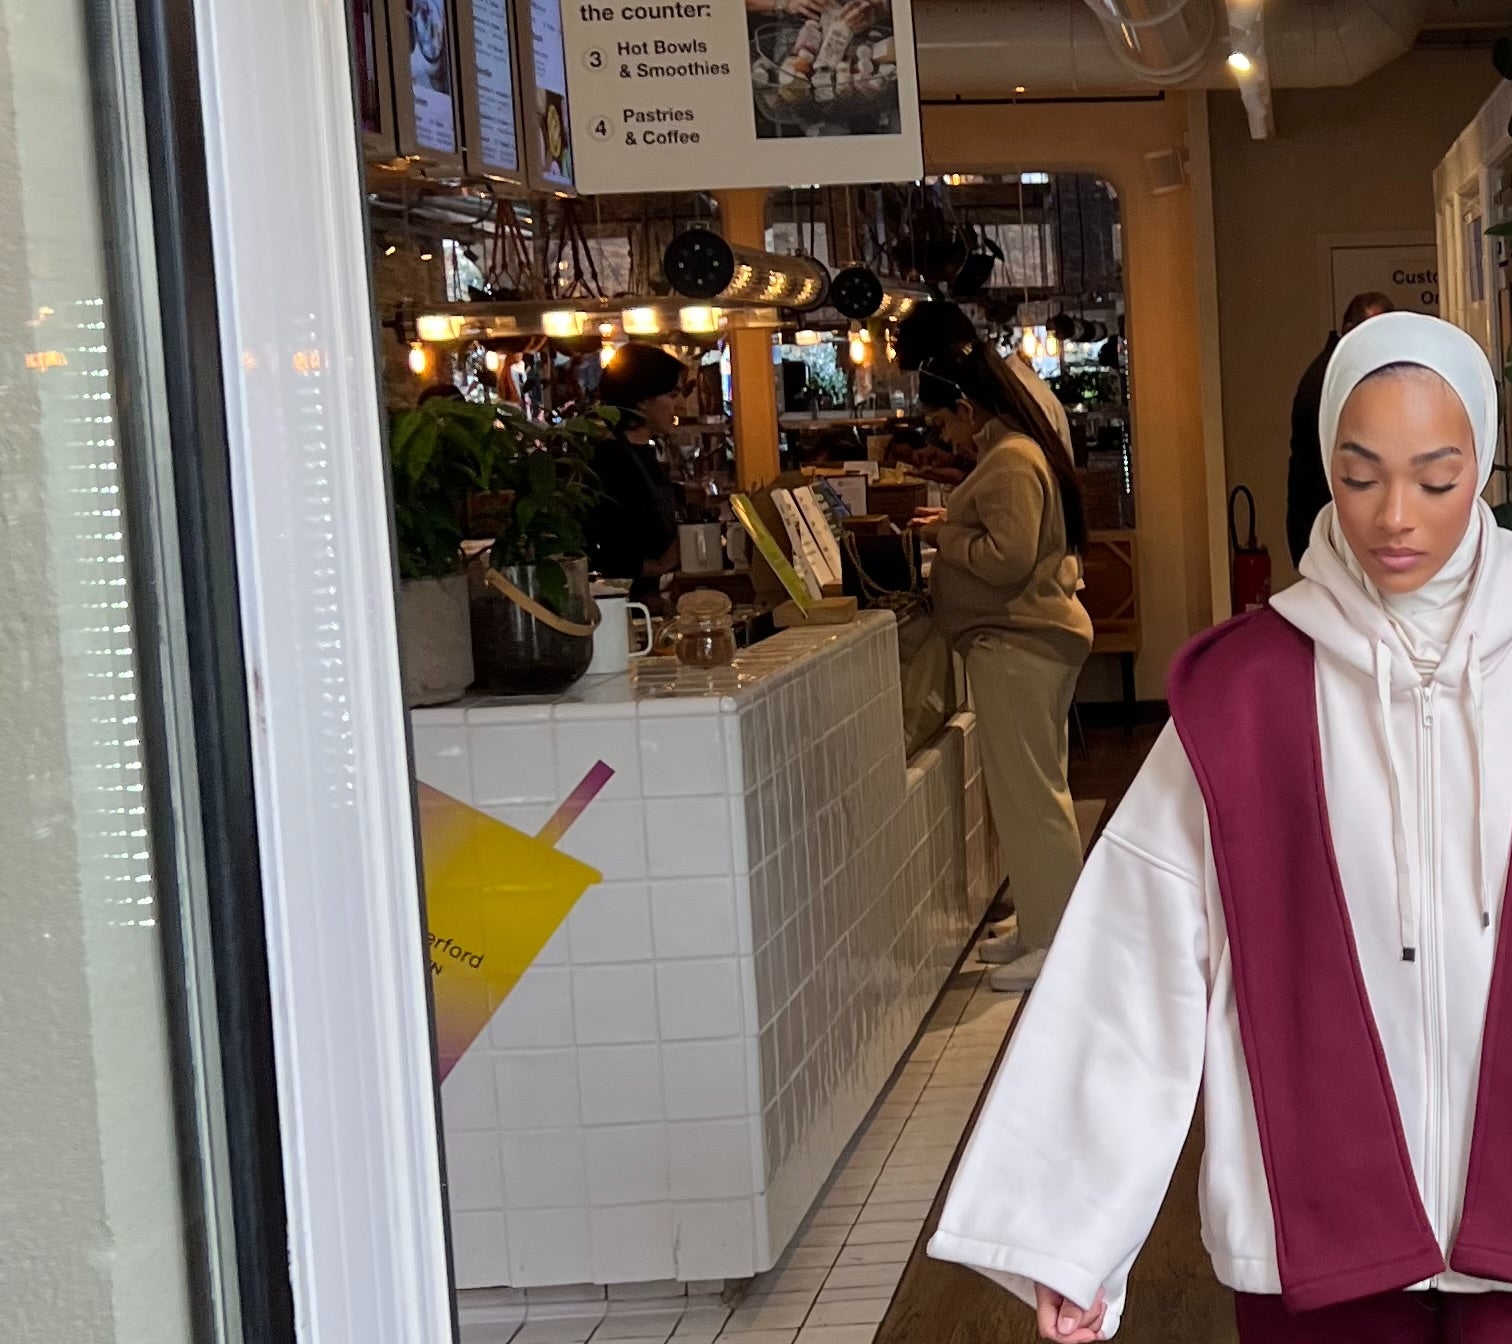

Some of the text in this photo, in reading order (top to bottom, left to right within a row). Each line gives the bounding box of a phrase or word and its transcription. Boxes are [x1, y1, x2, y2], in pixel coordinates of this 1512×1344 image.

[581, 2, 711, 22] the counter:
[617, 38, 707, 57] Hot Bowls
[589, 51, 602, 68] 3
[619, 60, 730, 79] & Smoothies
[624, 108, 694, 124] Pastries
[595, 120, 607, 136] 4
[625, 129, 700, 145] & Coffee
